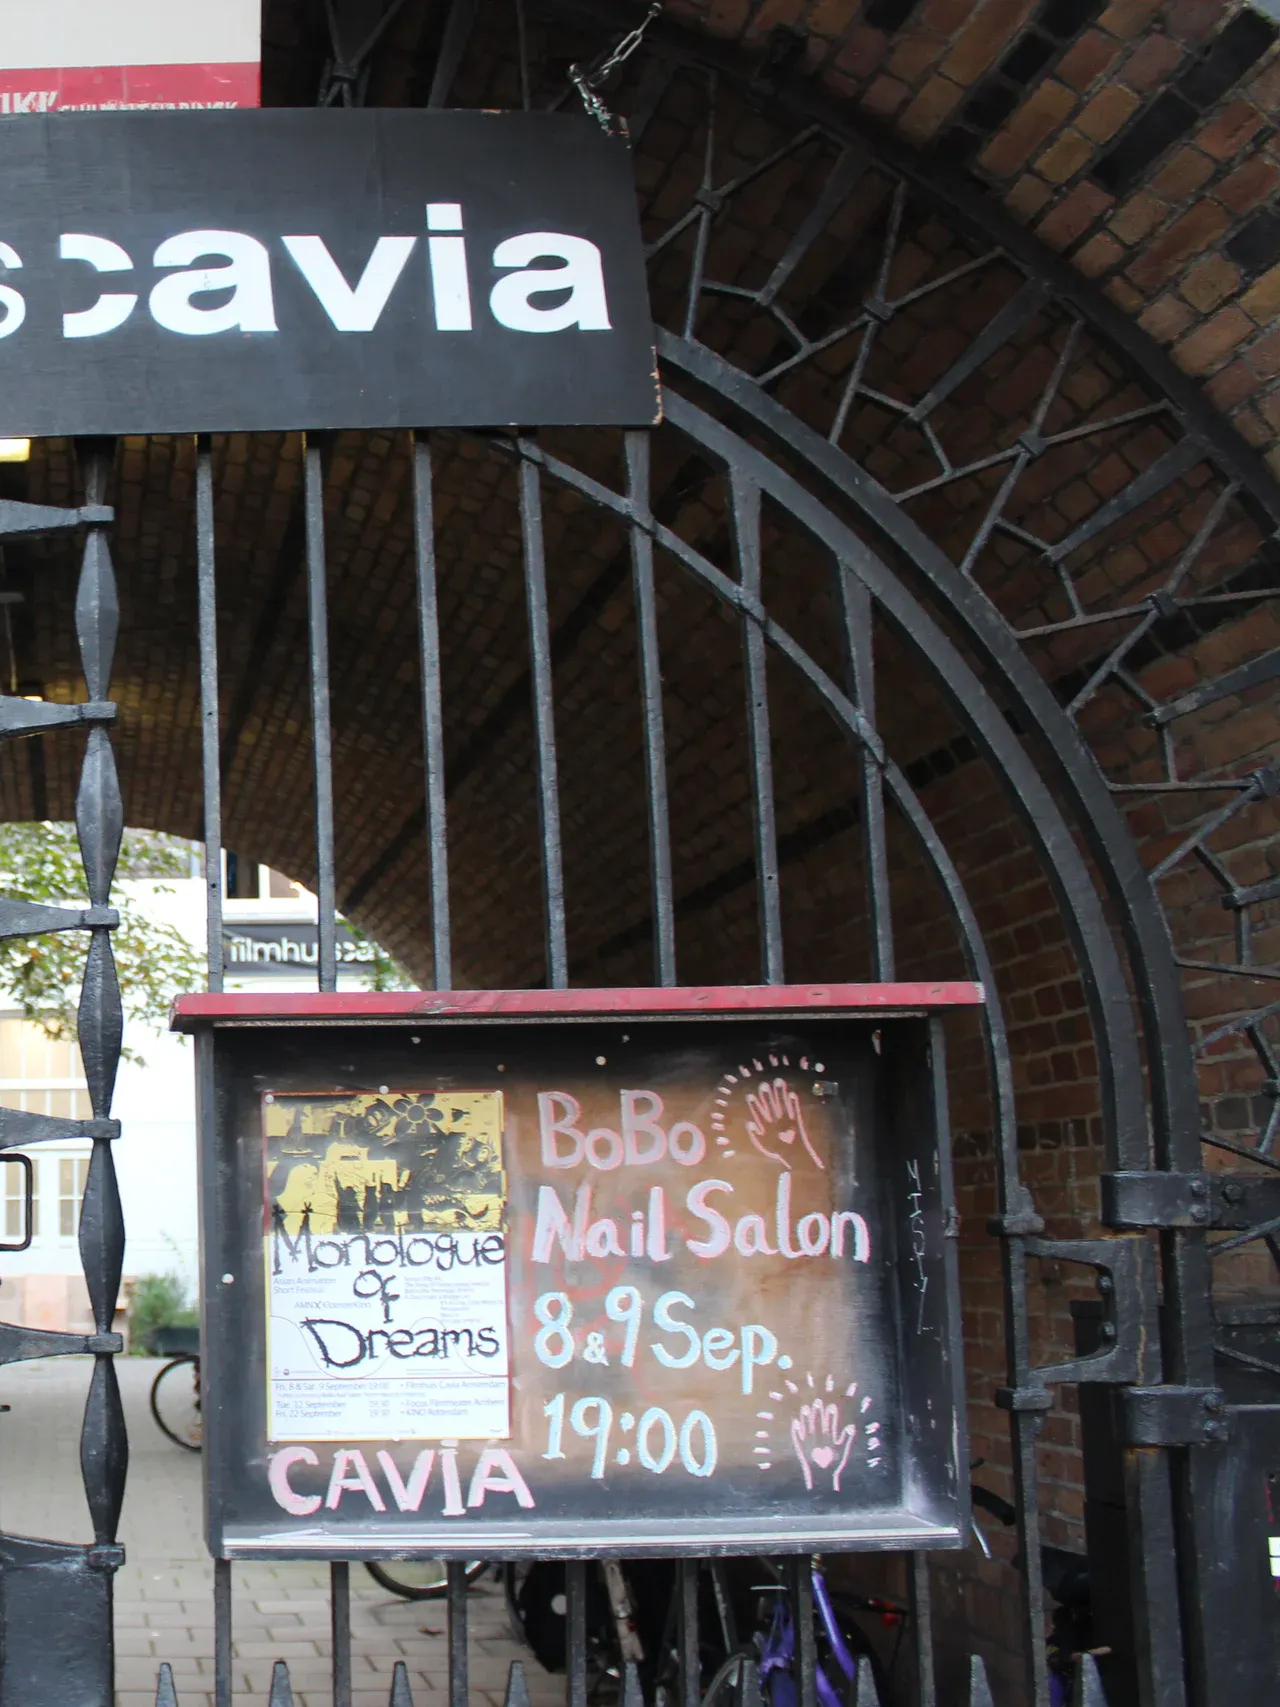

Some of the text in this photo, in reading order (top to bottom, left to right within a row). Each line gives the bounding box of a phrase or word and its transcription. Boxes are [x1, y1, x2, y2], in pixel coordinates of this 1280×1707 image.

[537, 1089, 706, 1170] BoBo
[272, 1202, 506, 1275] Monologue
[531, 1185, 672, 1263] Nail
[686, 1171, 870, 1263] Salon
[353, 1269, 400, 1324] of
[300, 1317, 499, 1368] Dreams
[541, 1392, 718, 1479] 19:00
